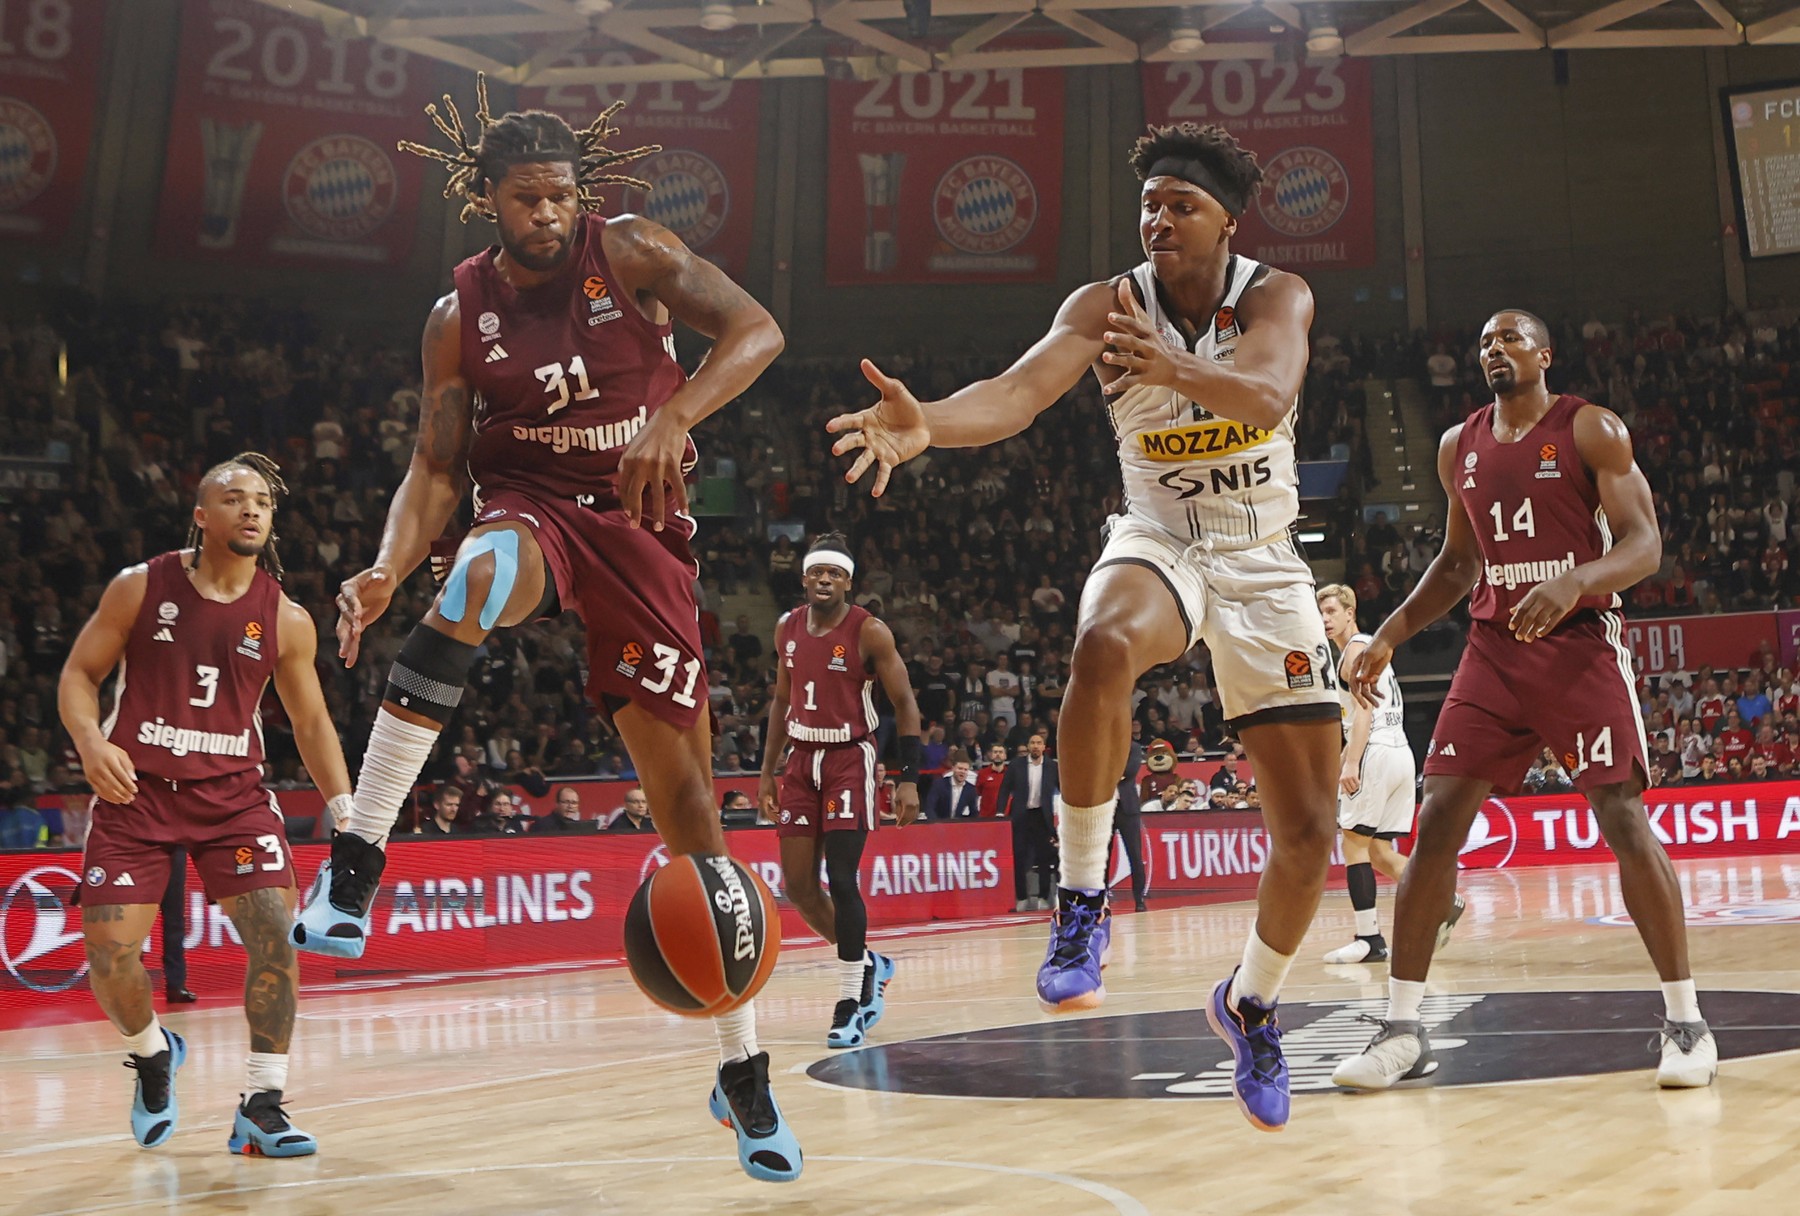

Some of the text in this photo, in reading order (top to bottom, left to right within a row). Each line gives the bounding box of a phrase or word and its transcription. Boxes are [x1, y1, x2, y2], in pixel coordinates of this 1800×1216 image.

[206, 17, 408, 98] 2018
[853, 67, 1036, 120] 2021
[1166, 56, 1346, 117] 2023
[1765, 98, 1800, 121] FC
[963, 160, 1029, 201] BAYERN
[1283, 152, 1344, 184] BAYERN
[533, 355, 600, 416] 31
[1142, 420, 1270, 456] MOZZAR
[1210, 456, 1272, 495] NIS
[1489, 497, 1536, 542] 14
[188, 664, 220, 708] 3
[640, 642, 701, 709] 31
[803, 680, 818, 711] 1
[137, 716, 251, 757] siegmund
[1576, 726, 1614, 767] 14
[839, 790, 855, 819] 1
[1532, 799, 1760, 851] TUKISH
[256, 833, 285, 871] 3
[870, 849, 1001, 898] AIRLINES
[1160, 826, 1273, 881] TURKIS
[386, 869, 595, 936] AIRLINES
[706, 854, 757, 963] SPALDING
